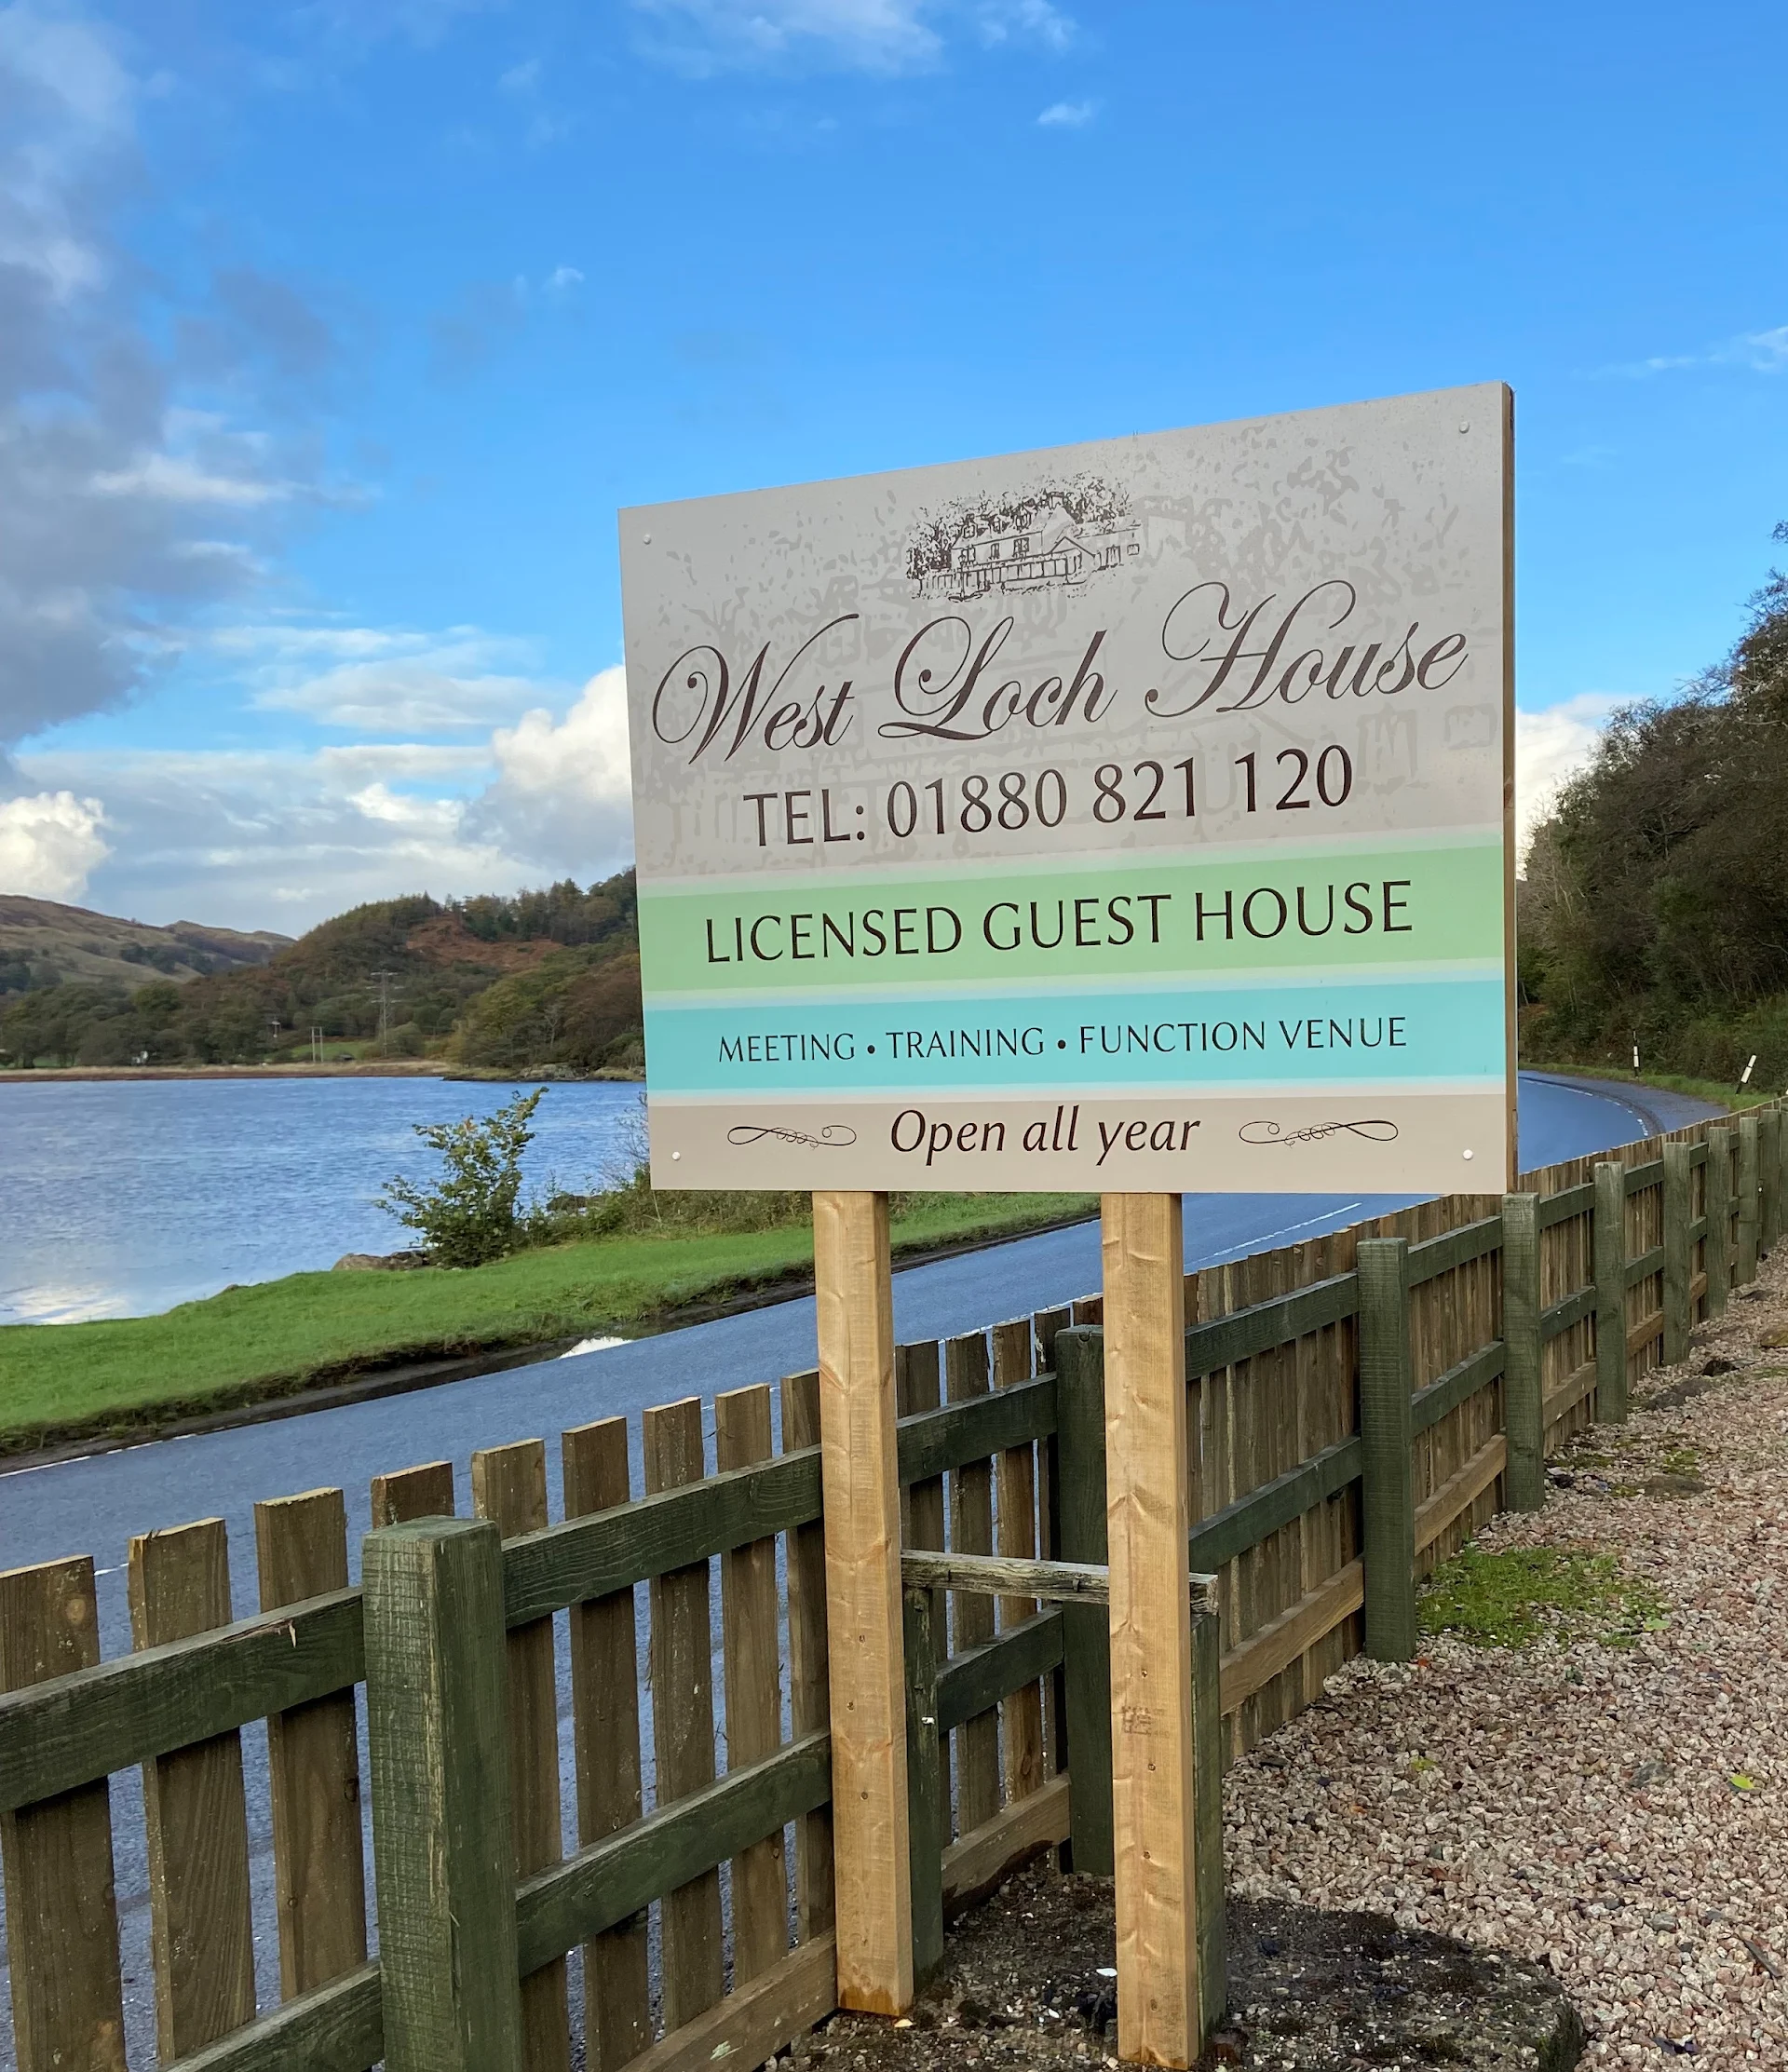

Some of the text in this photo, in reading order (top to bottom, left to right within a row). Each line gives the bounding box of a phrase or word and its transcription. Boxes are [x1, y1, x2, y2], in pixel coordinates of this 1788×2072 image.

[652, 579, 1470, 765] West Loch House
[742, 744, 1352, 847] TEL: 01880 821 120
[706, 880, 1413, 963] LICENSED GUEST HOUSE
[719, 1016, 1407, 1063] MEETING TRAINING FUNCTION VENUE
[890, 1104, 1201, 1167] Open all year
